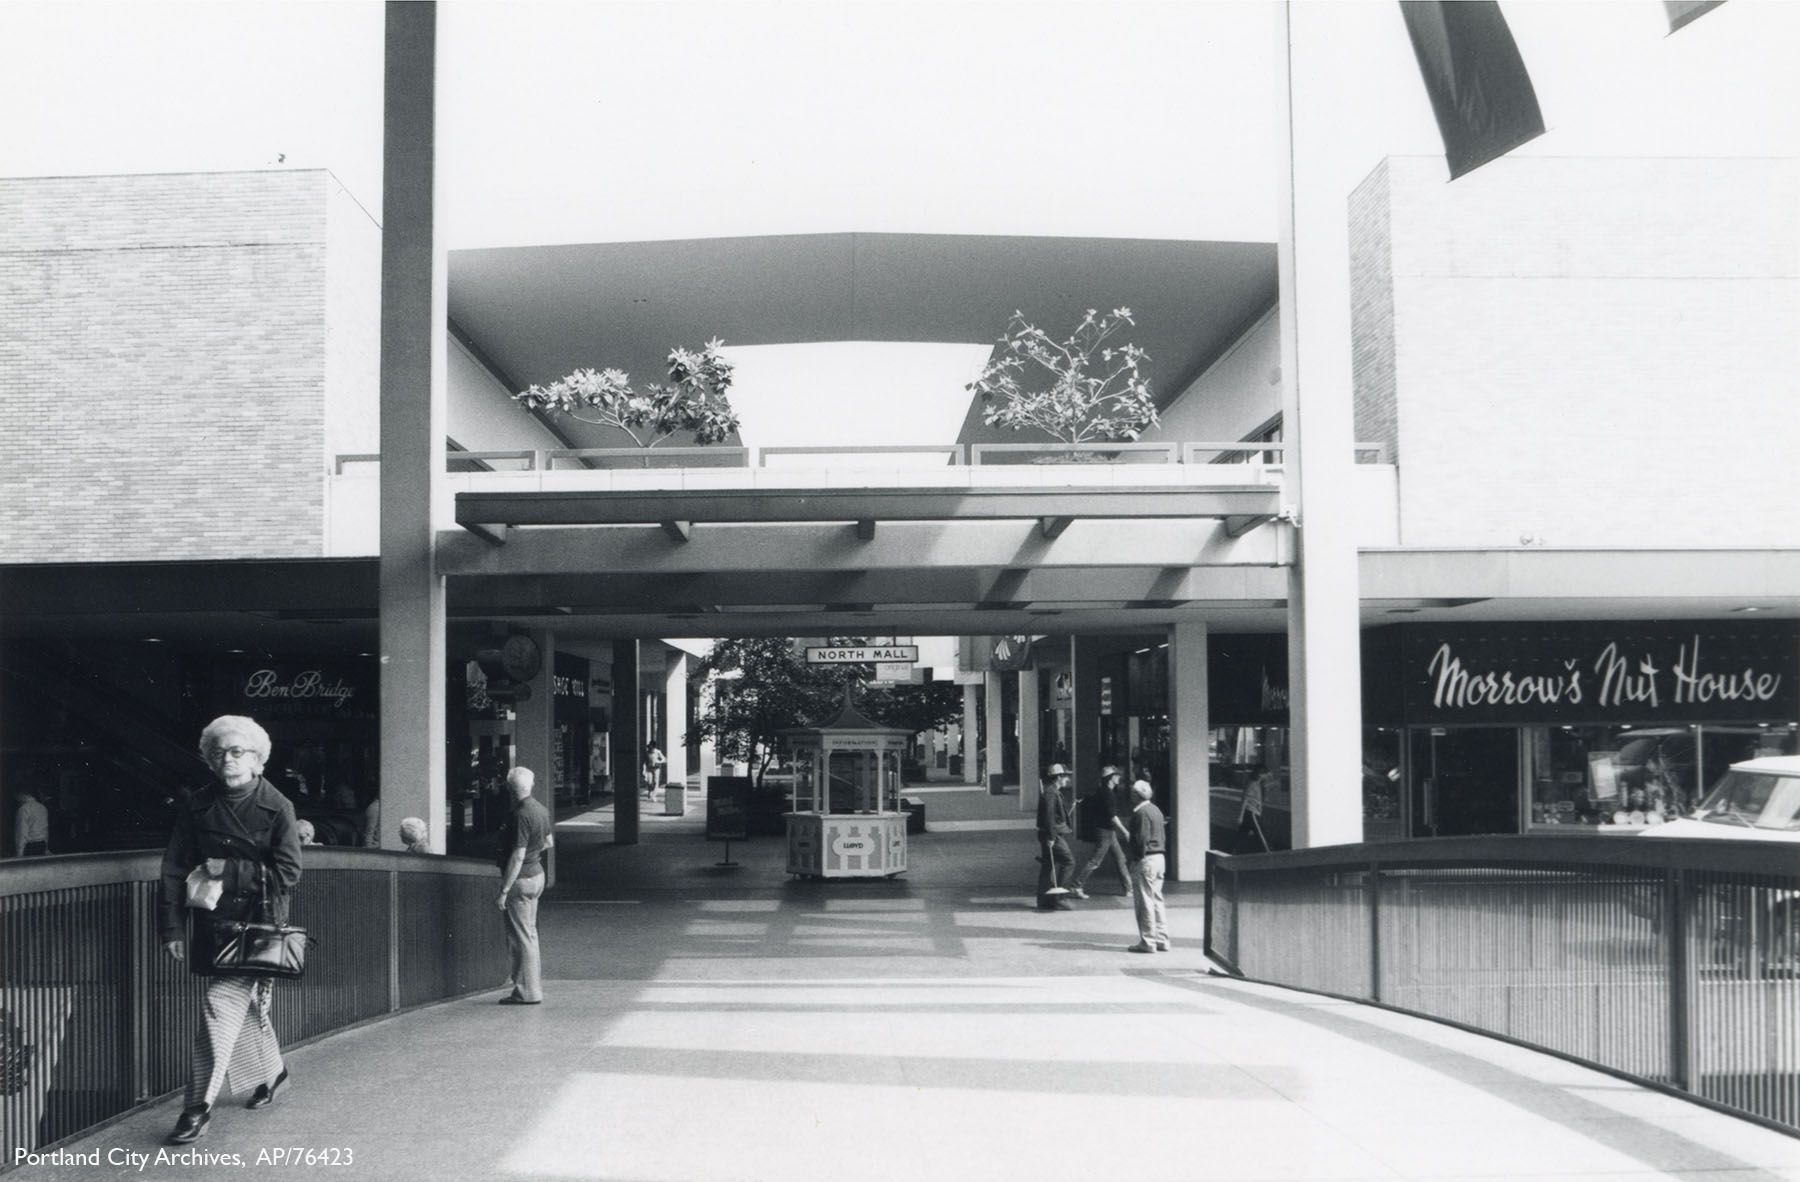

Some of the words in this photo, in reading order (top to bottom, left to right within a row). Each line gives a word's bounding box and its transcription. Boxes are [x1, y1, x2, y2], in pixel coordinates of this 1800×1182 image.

[818, 651, 864, 660] NORTH
[873, 649, 907, 659] MALL
[1427, 642, 1581, 709] Morrow's
[1594, 641, 1659, 708] Nut
[1672, 633, 1781, 704] House
[245, 669, 289, 697] Ben
[290, 671, 354, 707] Bridge
